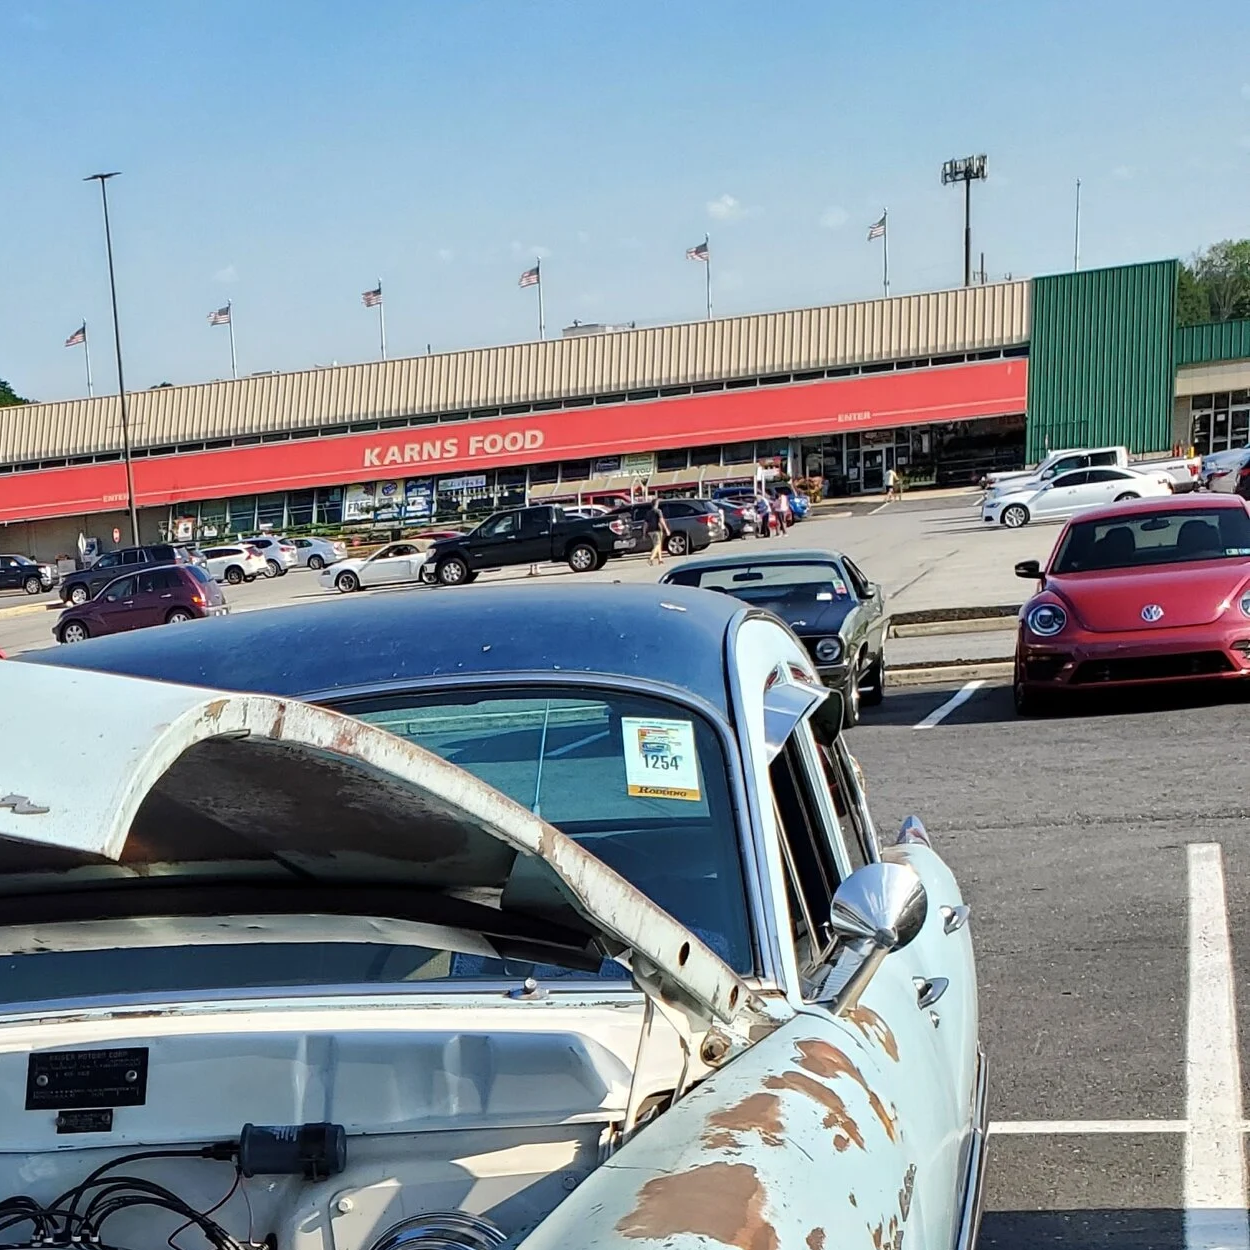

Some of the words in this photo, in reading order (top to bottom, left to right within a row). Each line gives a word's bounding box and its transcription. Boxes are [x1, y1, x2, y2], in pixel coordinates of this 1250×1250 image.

[837, 411, 871, 422] ENTER
[364, 438, 459, 467] KARNS
[469, 430, 544, 455] FOOD
[643, 754, 679, 770] 1254
